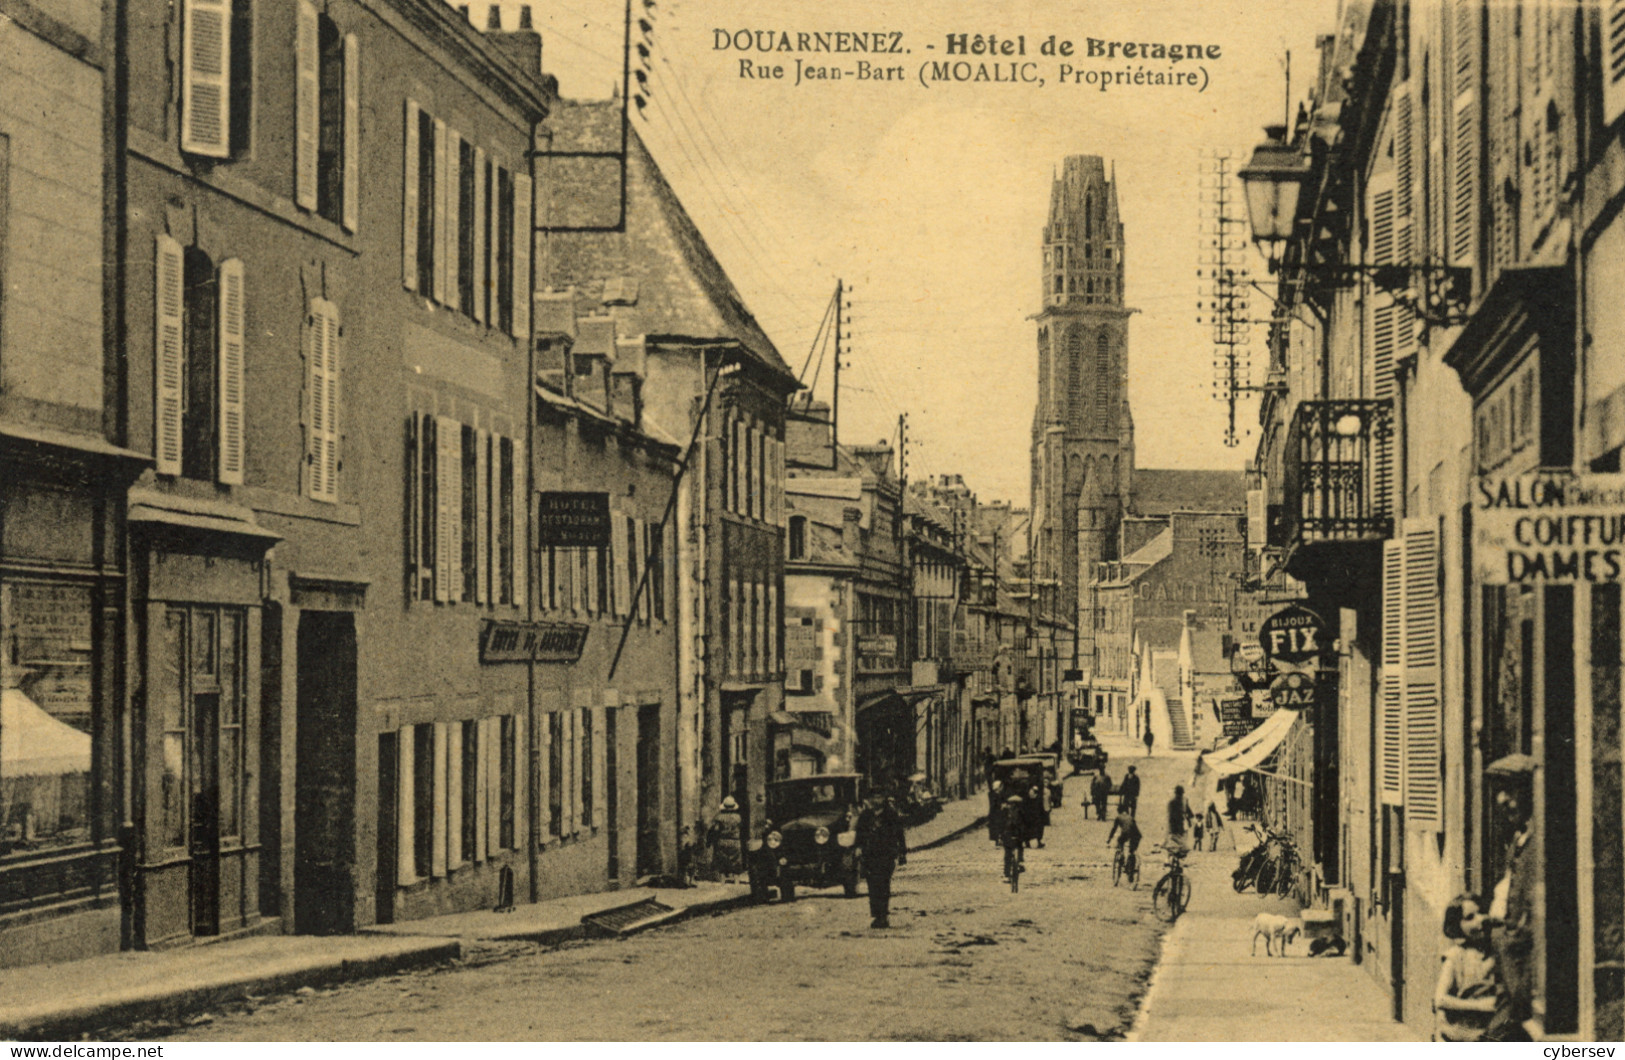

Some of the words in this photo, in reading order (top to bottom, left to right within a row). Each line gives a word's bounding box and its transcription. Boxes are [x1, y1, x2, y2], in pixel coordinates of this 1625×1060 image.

[1479, 480, 1564, 509] SALON
[1508, 550, 1620, 582] DAMES
[1271, 616, 1313, 628] BIJOUX
[1269, 627, 1319, 654] FIX
[1275, 688, 1315, 705] JAZ
